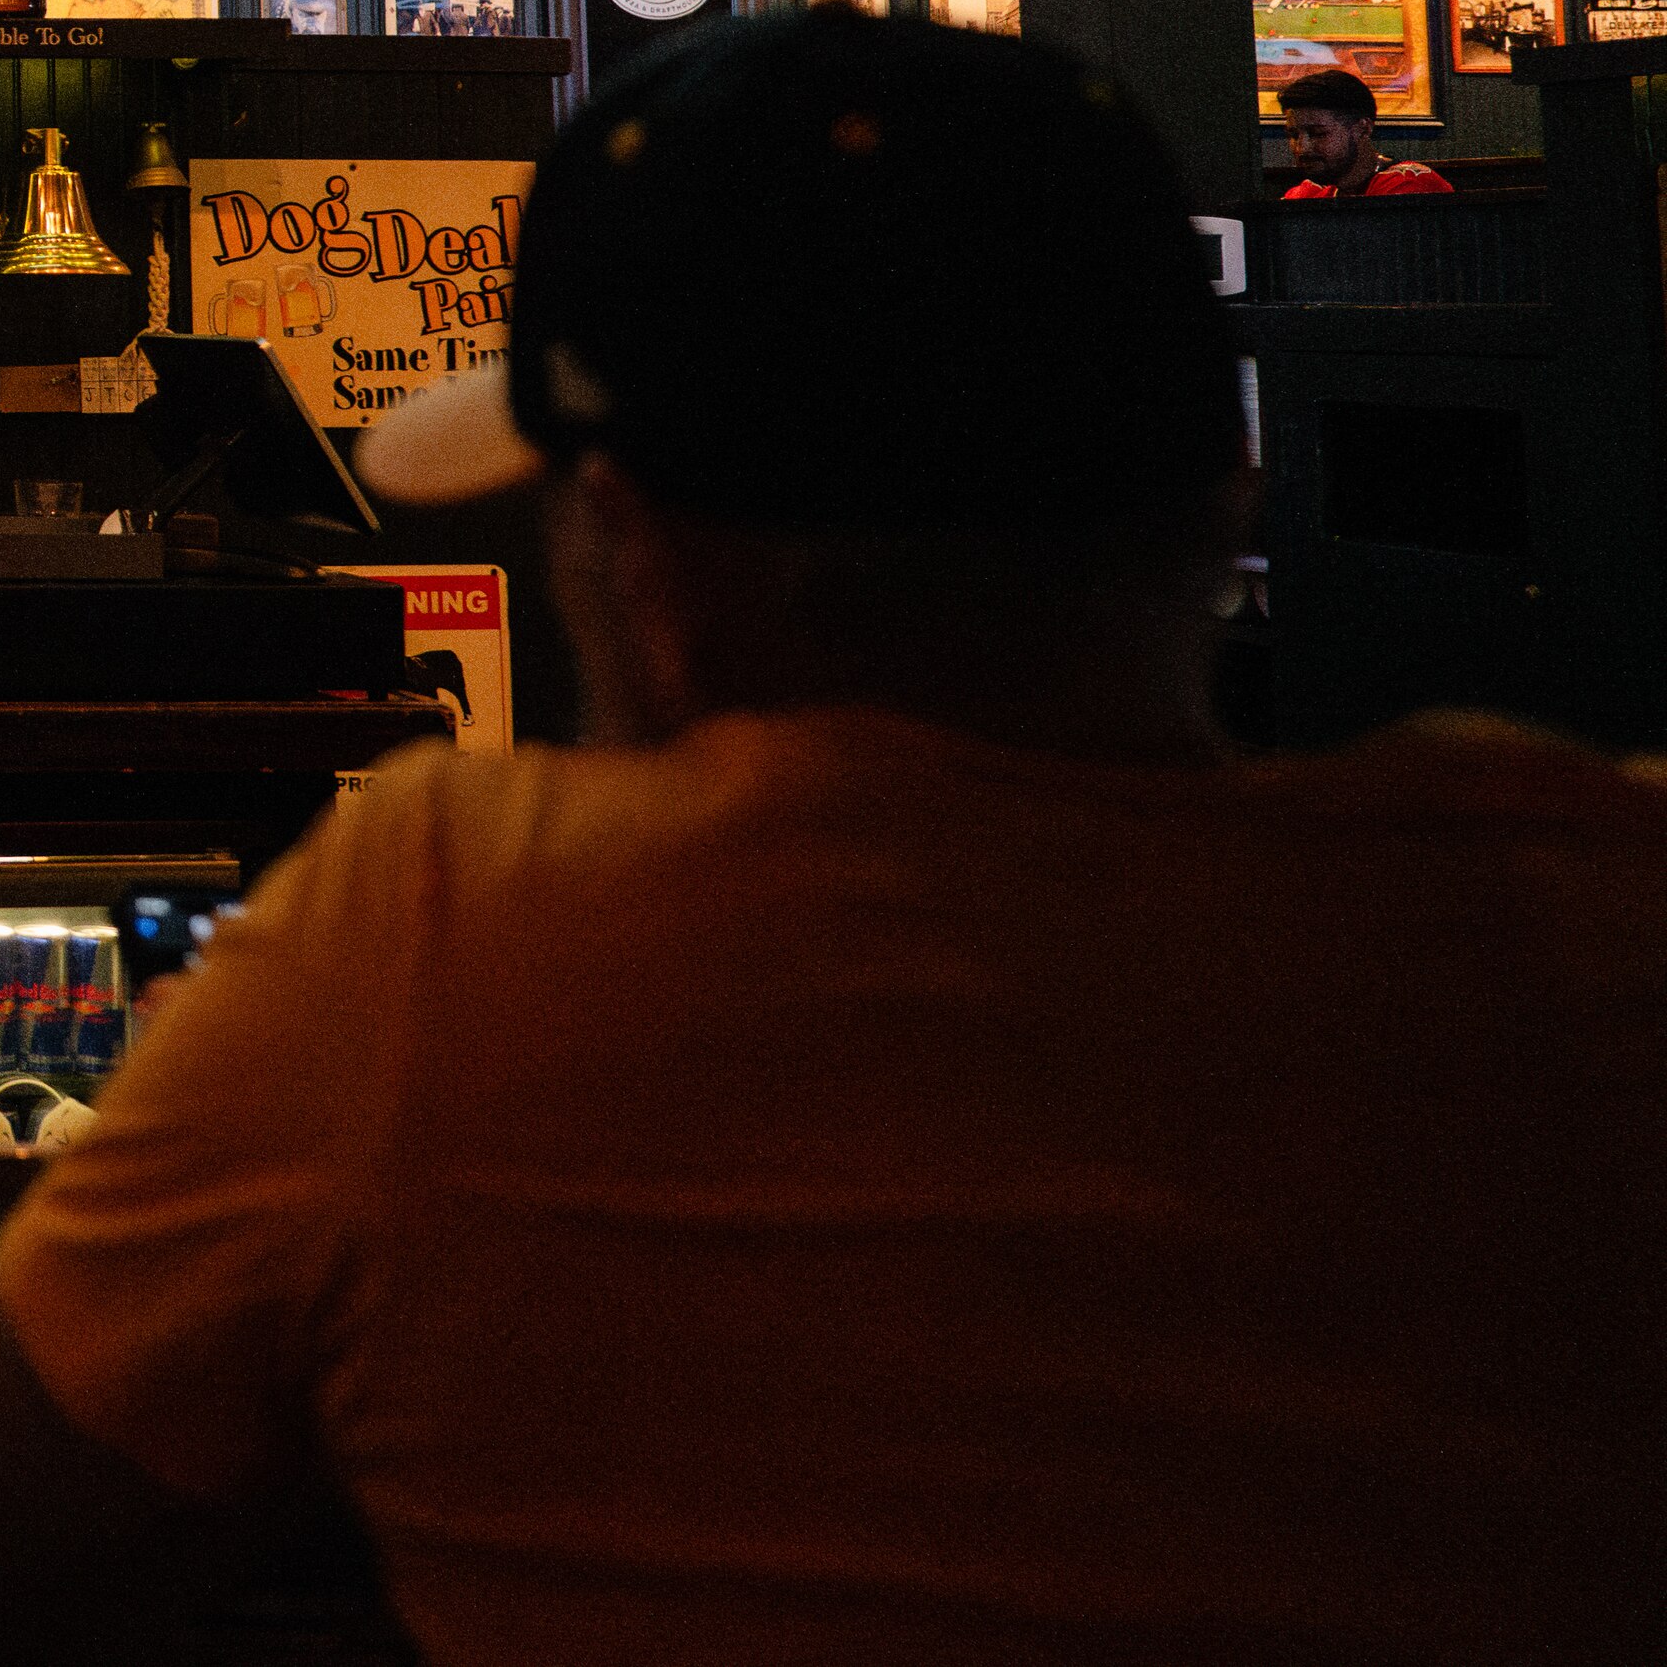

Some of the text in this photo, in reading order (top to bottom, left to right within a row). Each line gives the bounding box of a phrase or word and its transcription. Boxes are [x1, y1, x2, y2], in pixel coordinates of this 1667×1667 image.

[35, 27, 61, 46] To
[67, 26, 104, 46] Go!
[201, 175, 523, 283] Dog Deal
[332, 336, 511, 372] Same Tim
[406, 590, 489, 614] NING
